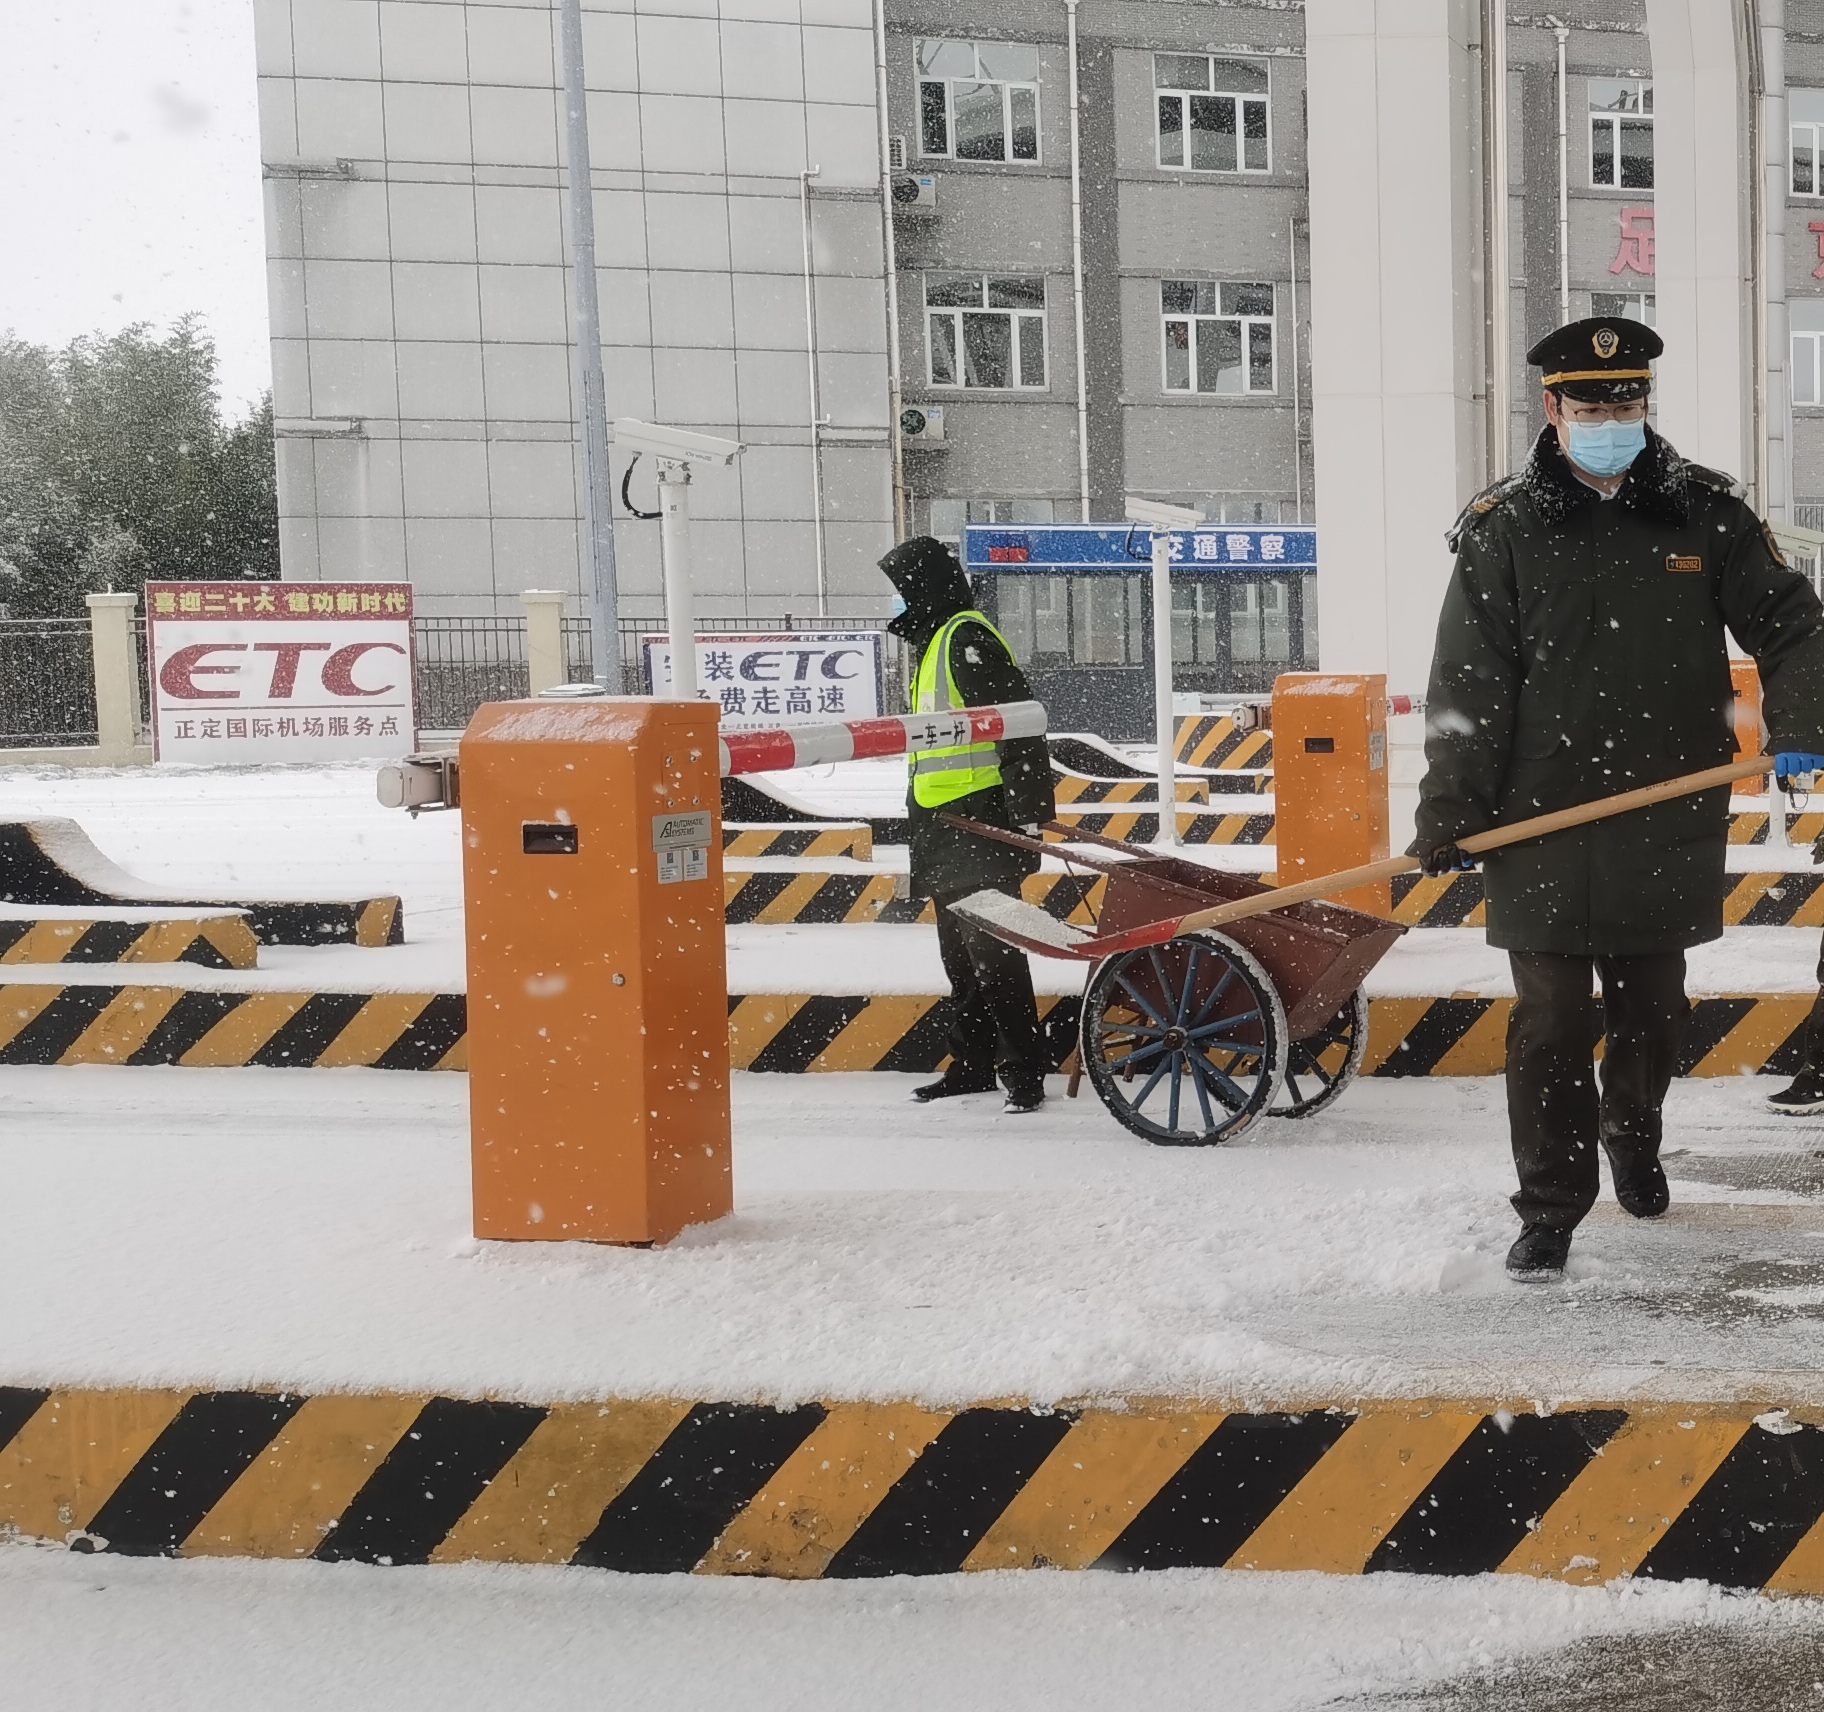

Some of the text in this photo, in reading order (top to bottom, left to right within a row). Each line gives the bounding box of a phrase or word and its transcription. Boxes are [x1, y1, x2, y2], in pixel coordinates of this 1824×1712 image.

[154, 591, 406, 613] 喜迎二十大 建功新时代
[159, 642, 407, 700] ETC
[174, 715, 400, 740] 正定国际机场服务点
